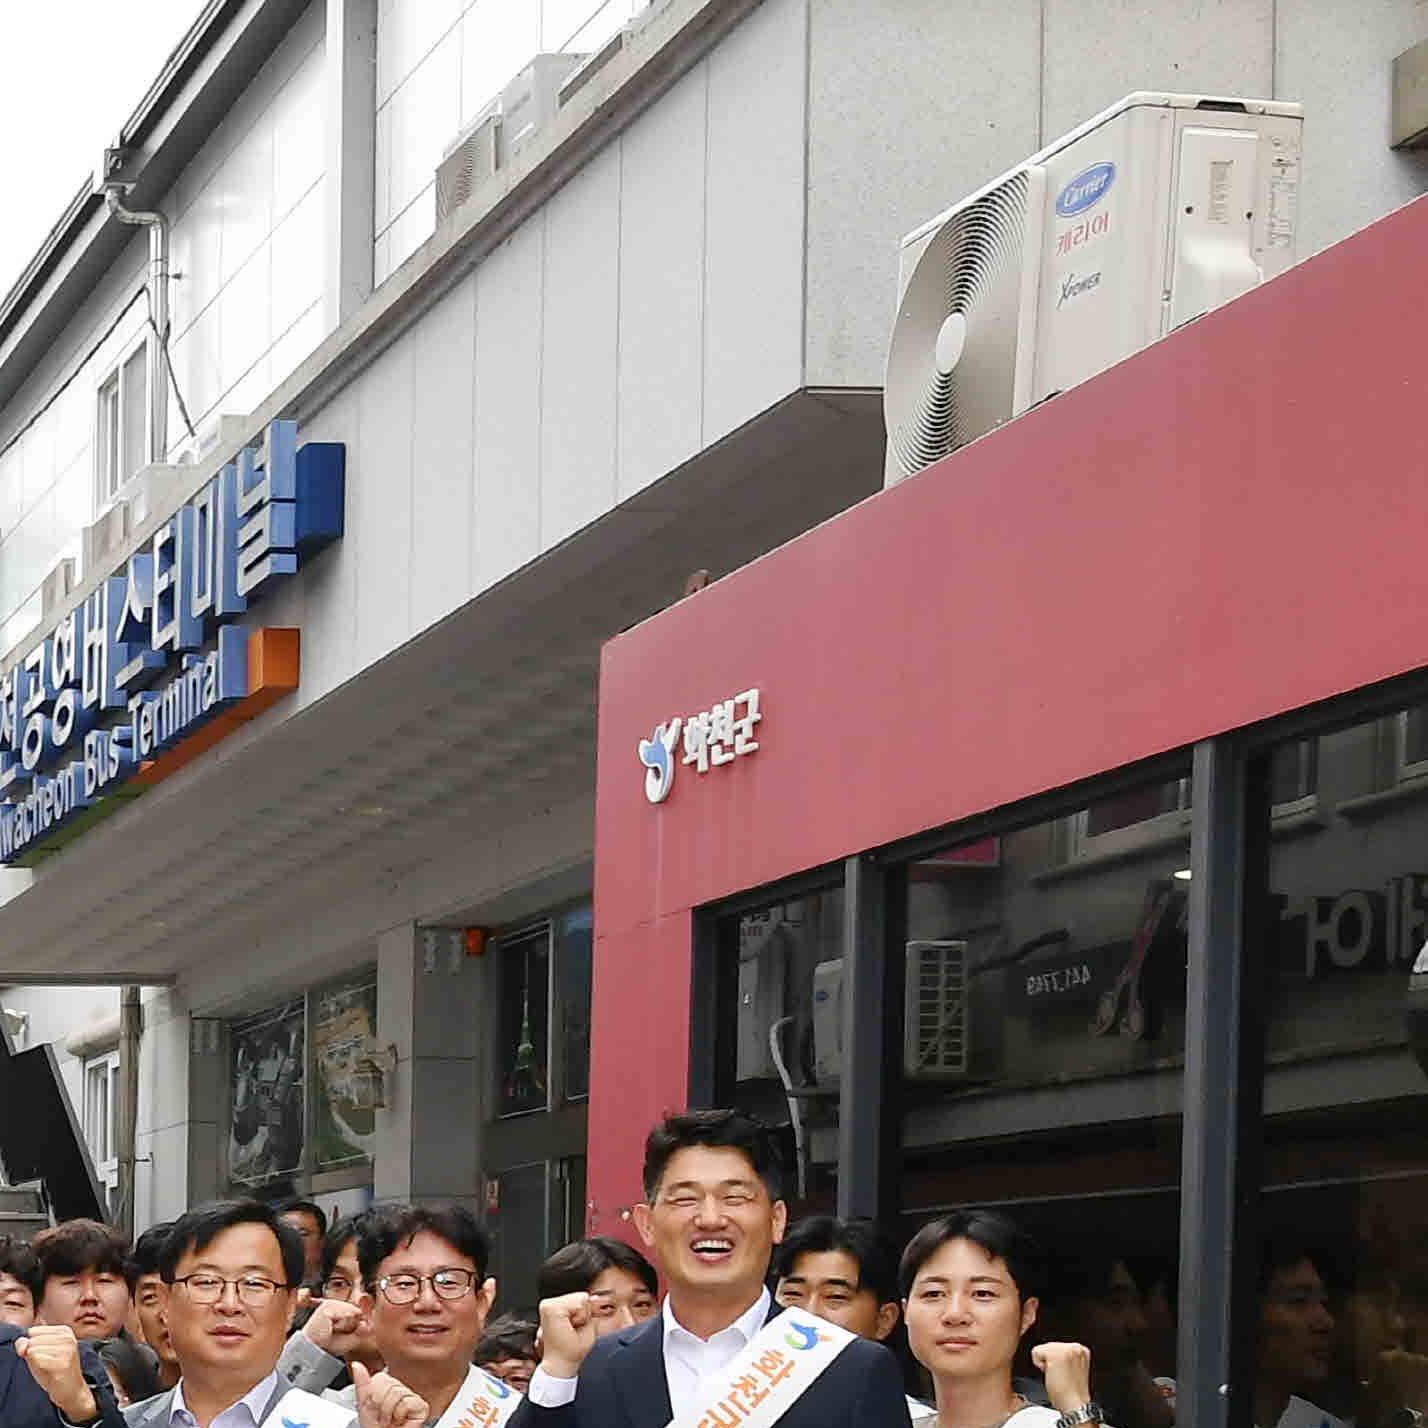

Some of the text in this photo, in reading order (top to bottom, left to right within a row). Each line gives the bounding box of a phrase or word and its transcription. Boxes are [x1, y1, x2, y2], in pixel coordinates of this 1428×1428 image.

[1064, 172, 1110, 208] Carrier
[1056, 210, 1109, 257] 캐리어
[84, 727, 124, 798] Bus
[128, 642, 224, 764] Terminal
[682, 688, 762, 773] 화천군
